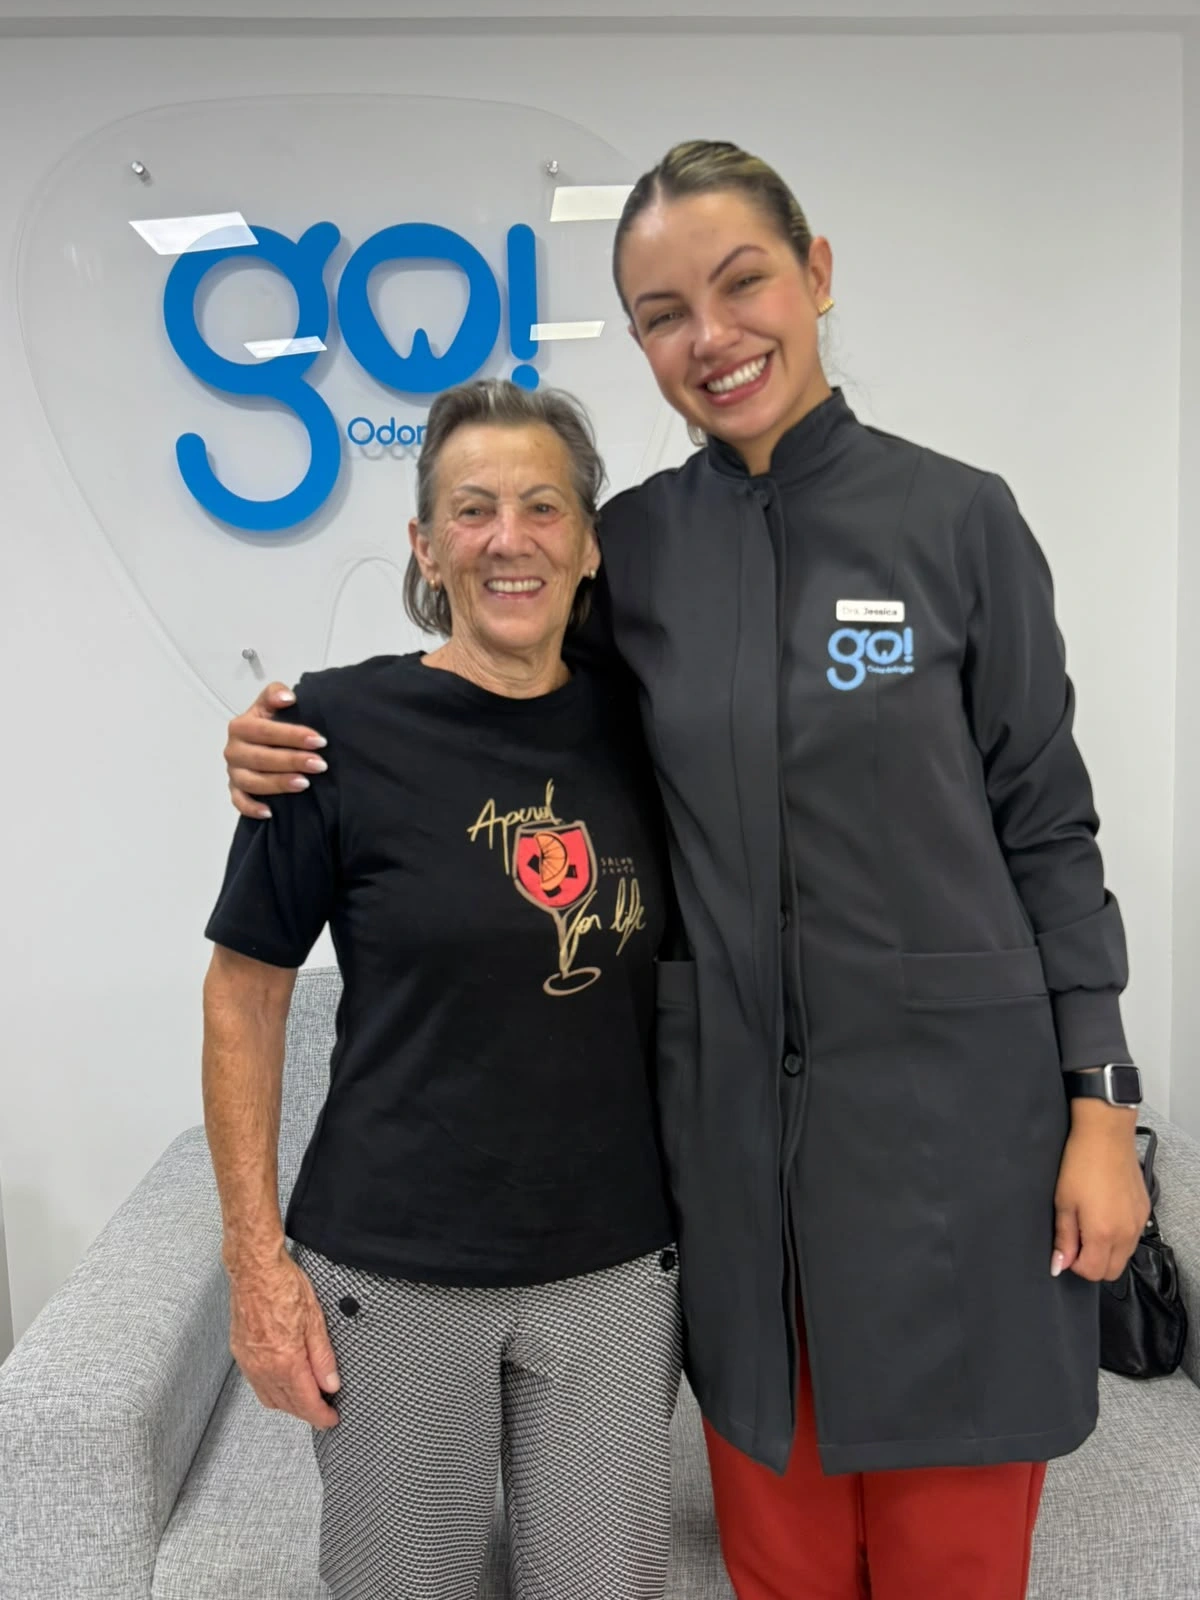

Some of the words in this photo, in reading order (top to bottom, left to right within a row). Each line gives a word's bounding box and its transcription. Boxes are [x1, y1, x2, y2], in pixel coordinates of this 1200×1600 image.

[163, 221, 539, 532] go!
[863, 607, 898, 616] Jessica
[826, 627, 914, 691] go!
[609, 878, 646, 956] life
